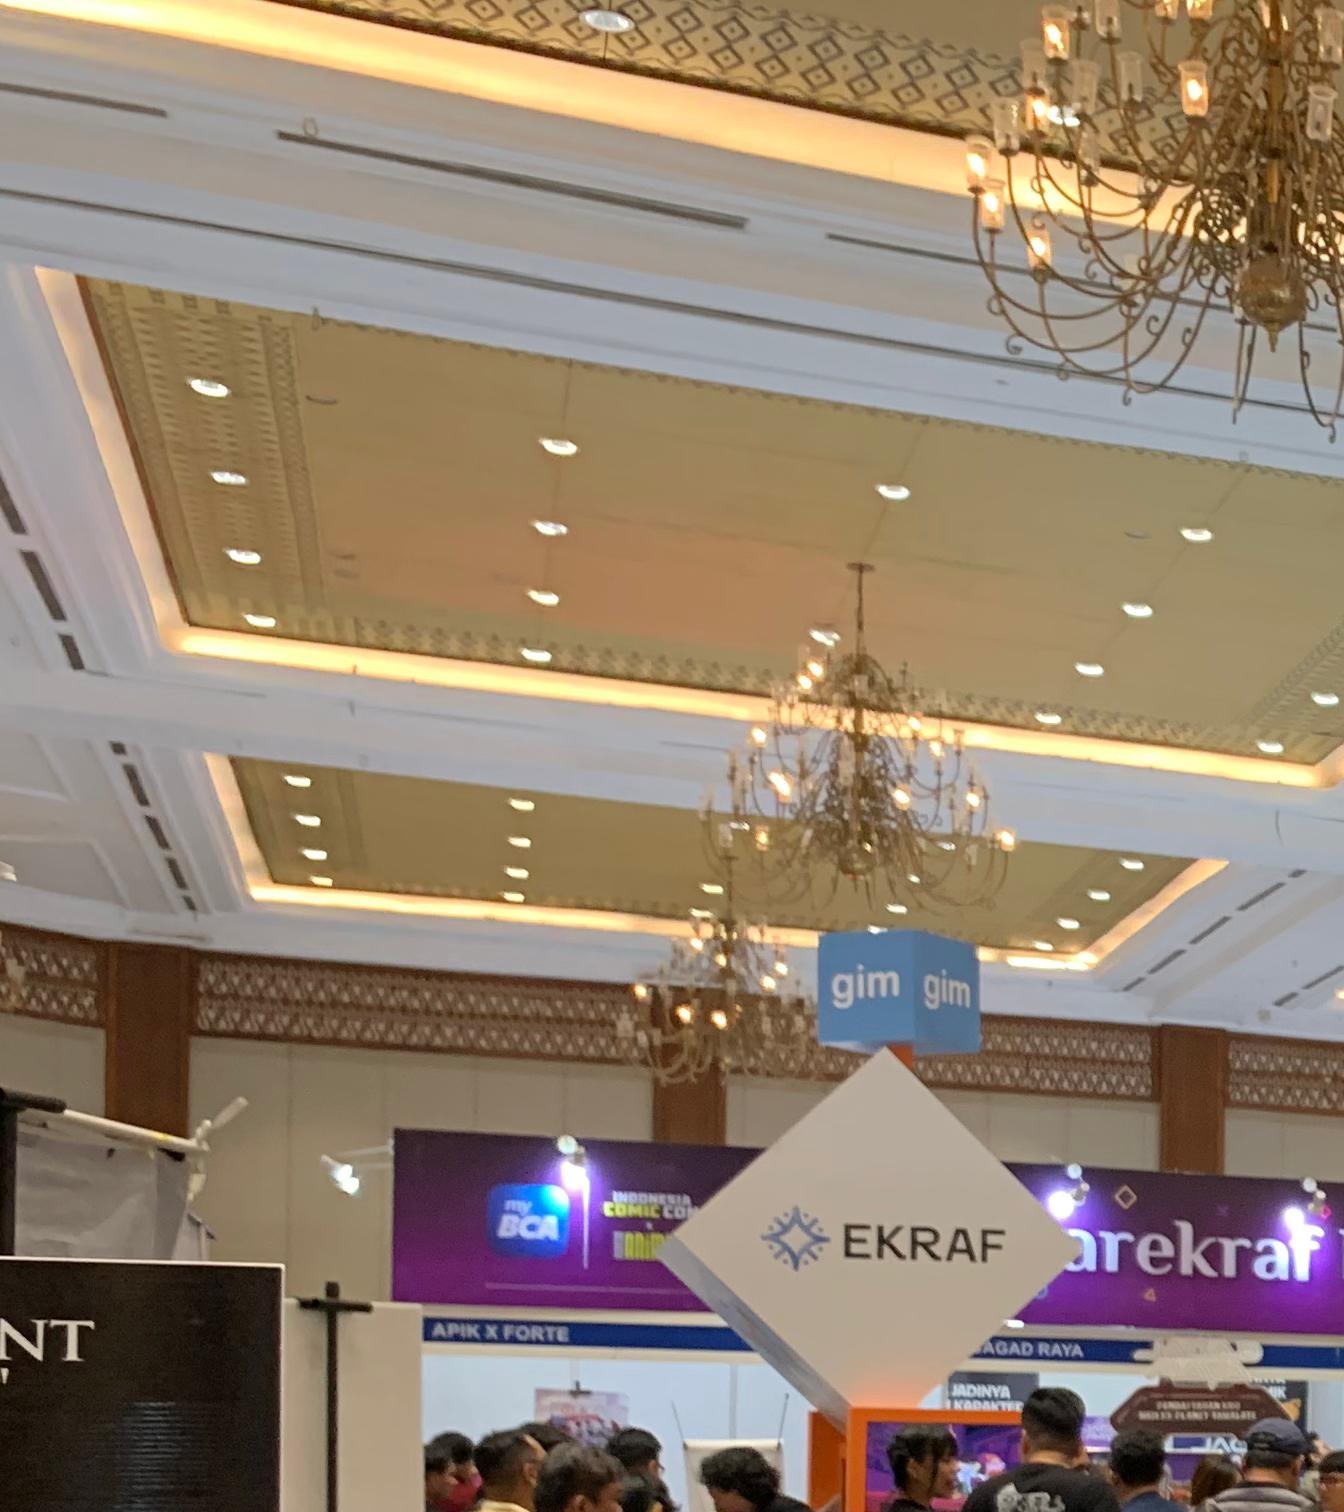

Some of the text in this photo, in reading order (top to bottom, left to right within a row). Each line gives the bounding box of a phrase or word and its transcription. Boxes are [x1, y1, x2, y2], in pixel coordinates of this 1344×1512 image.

[831, 964, 900, 1009] gim
[923, 970, 971, 1009] gim
[504, 1200, 532, 1215] my
[603, 1201, 660, 1218] COMIC
[497, 1214, 559, 1241] BCA
[842, 1224, 1006, 1264] EKRAF
[1063, 1217, 1325, 1282] arekraf
[0, 1318, 95, 1361] NT
[432, 1321, 569, 1343] APIK X FORTE
[1037, 1340, 1084, 1358] RAYA
[951, 1383, 1011, 1399] JADINYA
